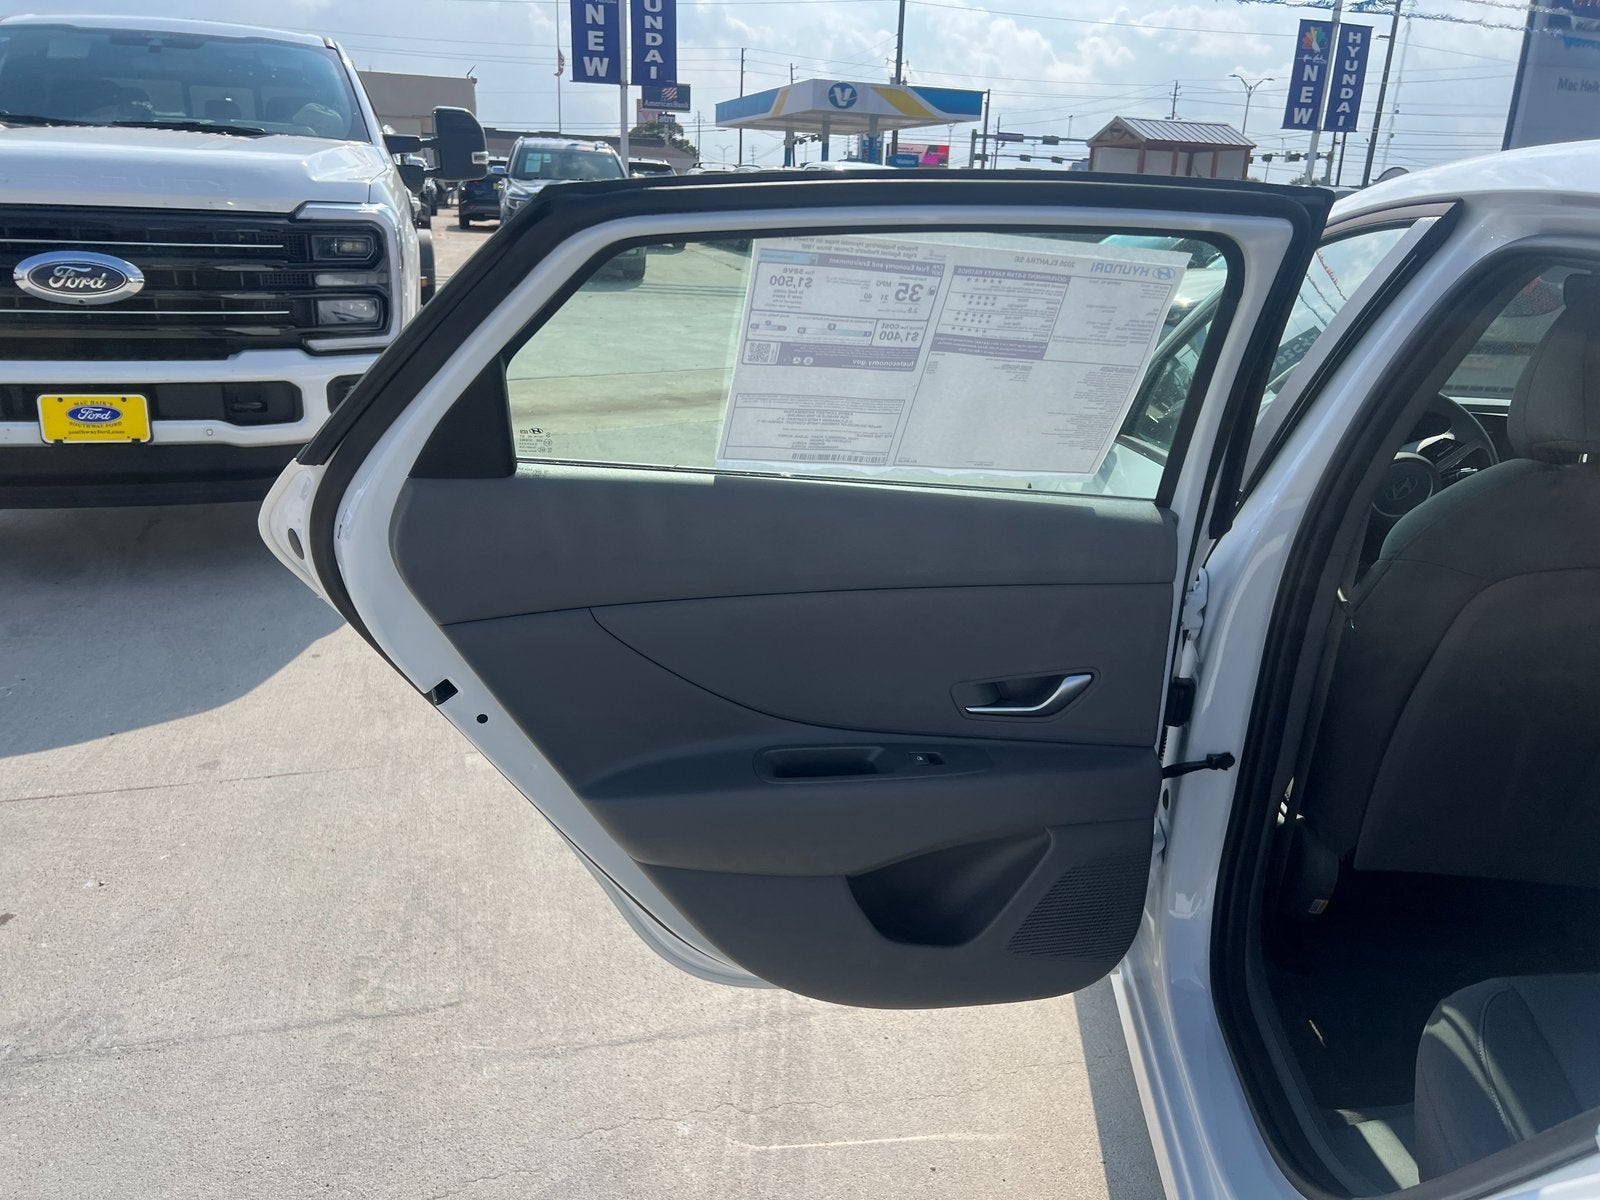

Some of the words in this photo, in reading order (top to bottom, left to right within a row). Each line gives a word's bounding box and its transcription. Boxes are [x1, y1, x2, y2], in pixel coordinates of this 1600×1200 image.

[583, 3, 609, 77] NEW
[1293, 64, 1318, 124] NEW
[1336, 31, 1362, 127] HYUNDAI
[1557, 77, 1578, 91] Mac
[48, 265, 108, 289] Ford
[77, 407, 111, 420] Ford
